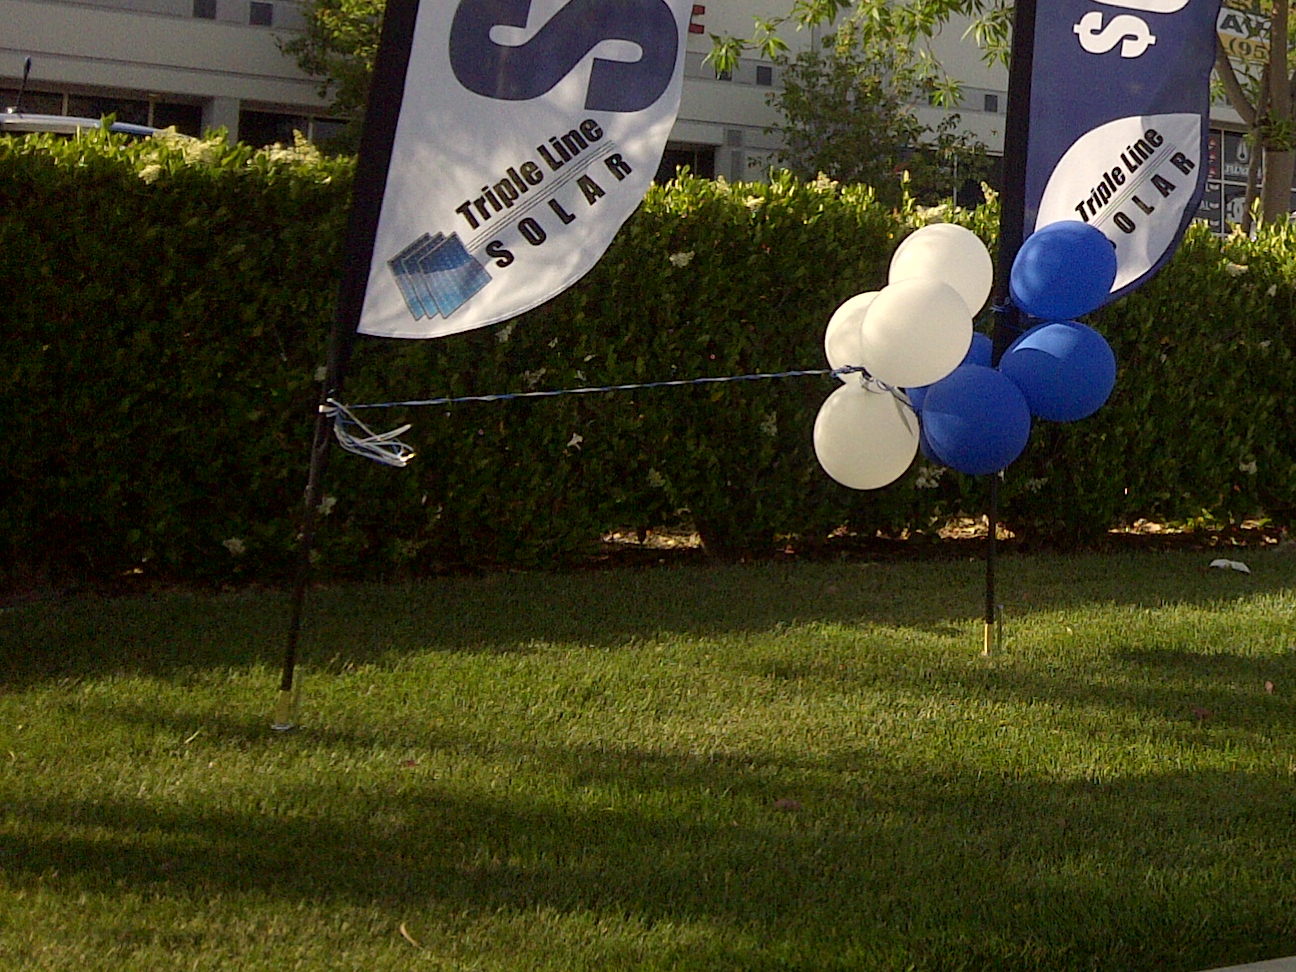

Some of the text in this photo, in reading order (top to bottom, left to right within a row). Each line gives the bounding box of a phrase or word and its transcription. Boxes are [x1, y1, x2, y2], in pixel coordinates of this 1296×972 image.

[455, 118, 604, 230] Triple Line
[485, 153, 632, 268] SOLAR
[1074, 128, 1164, 222] Triple Line
[1110, 151, 1196, 250] OLAR
